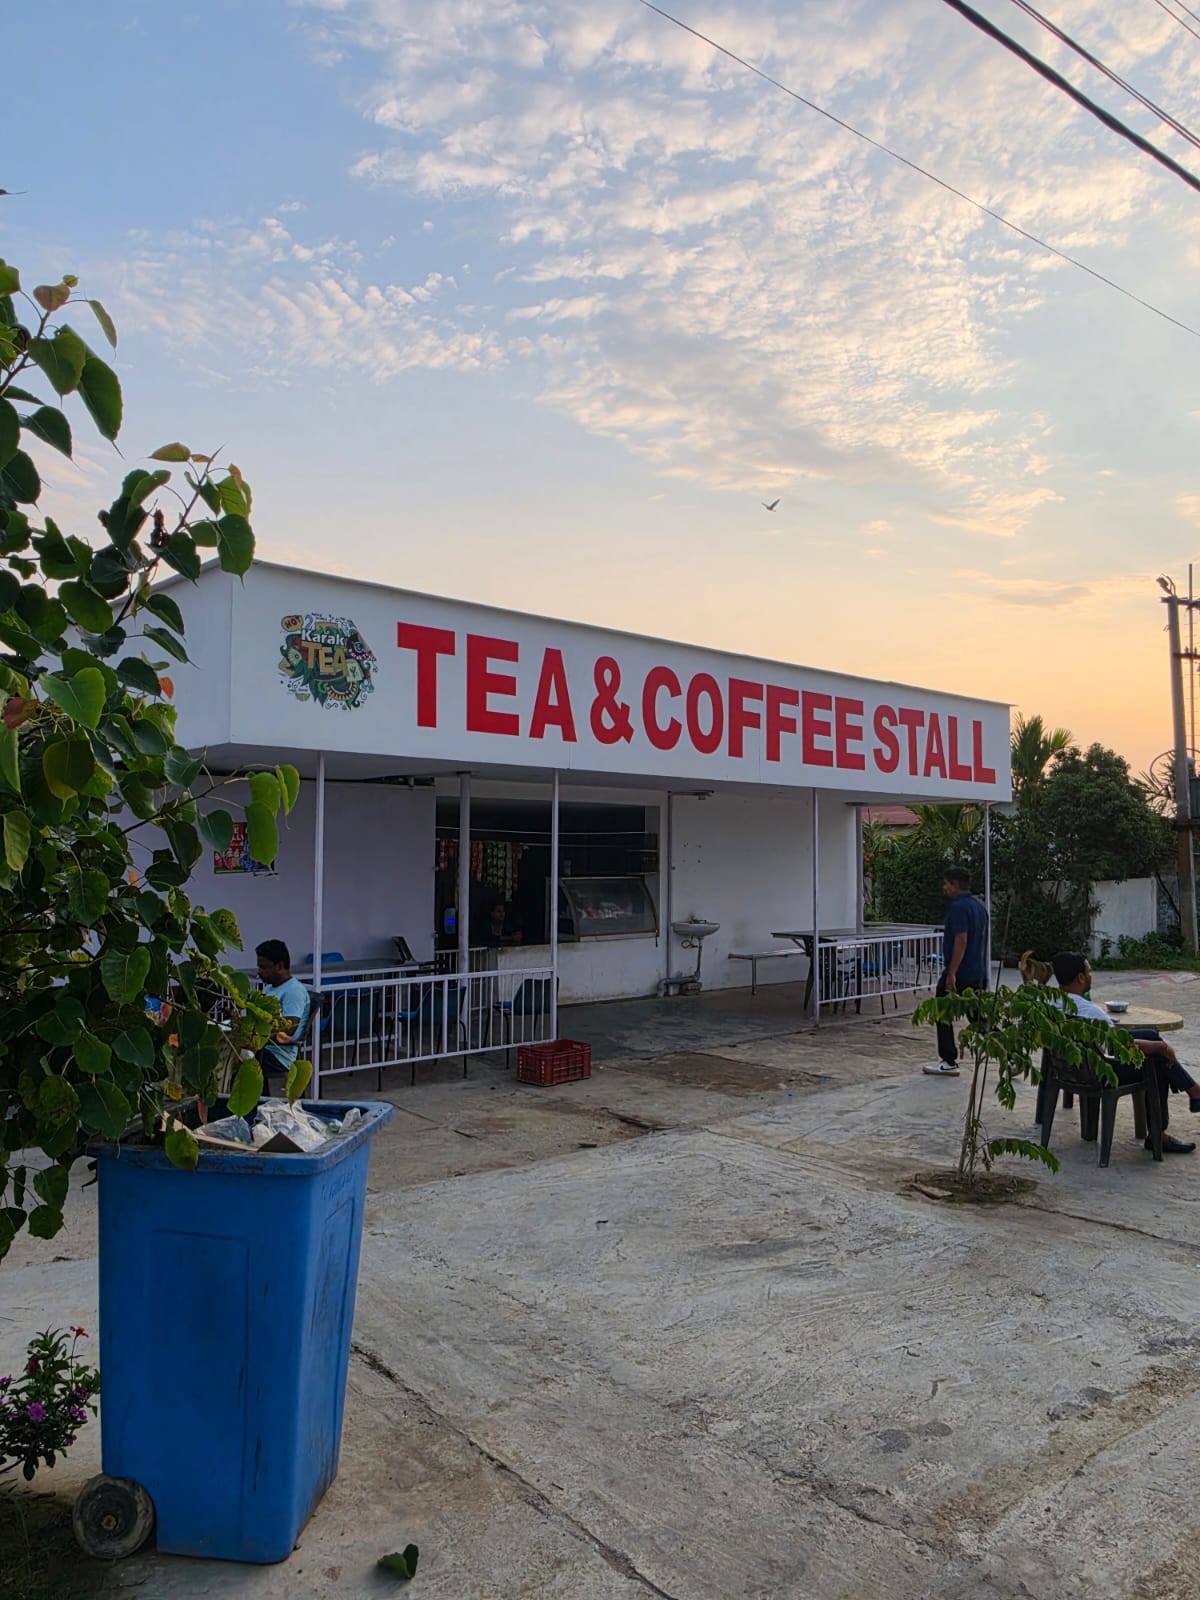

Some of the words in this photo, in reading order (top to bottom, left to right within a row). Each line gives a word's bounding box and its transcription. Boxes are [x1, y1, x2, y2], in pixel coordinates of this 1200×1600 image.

[285, 616, 302, 628] HOT
[301, 629, 345, 646] Karak
[301, 641, 348, 677] TEA
[397, 622, 577, 742] TEA
[590, 656, 634, 745] &
[642, 666, 866, 771] COFFEE
[873, 705, 996, 783] STALL
